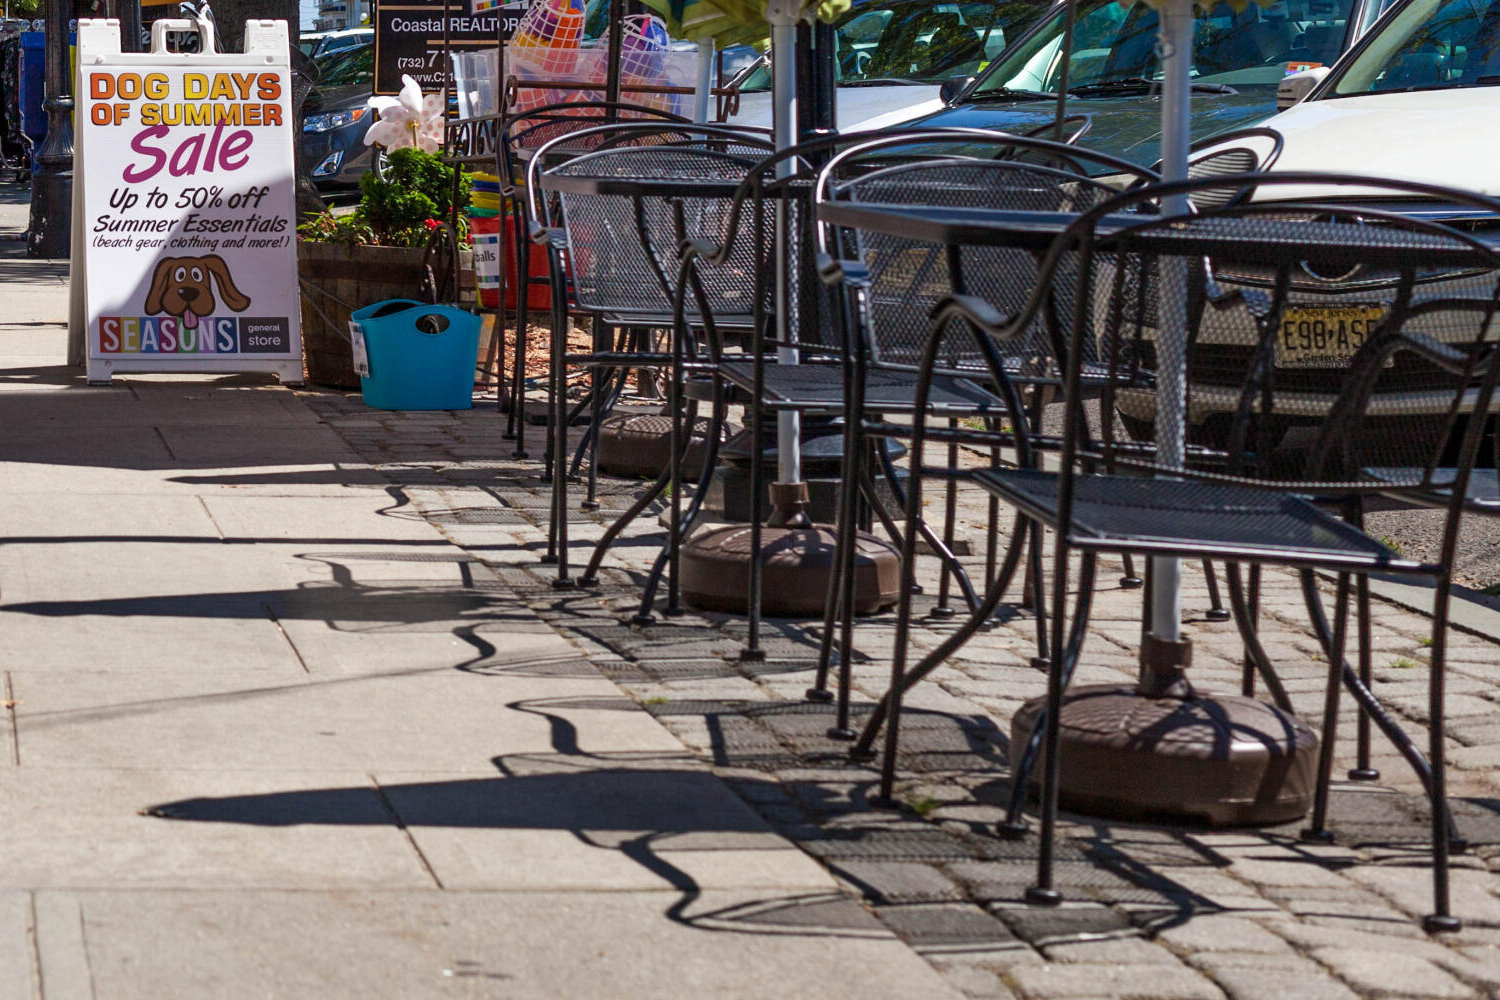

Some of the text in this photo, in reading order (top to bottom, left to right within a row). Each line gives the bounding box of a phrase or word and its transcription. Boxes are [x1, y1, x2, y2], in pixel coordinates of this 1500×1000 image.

[391, 17, 445, 33] Coastal
[397, 57, 425, 69] (732)
[90, 73, 281, 100] DOG DAYS
[91, 103, 283, 127] OF SUMMER
[122, 119, 254, 184] Sale
[109, 185, 270, 214] Up to 50% off
[93, 213, 288, 233] Summer Essentials
[93, 235, 290, 251] (beach gear, clothing and more!)
[103, 319, 235, 351] SEASONS
[248, 324, 280, 334] general
[248, 334, 282, 346] store
